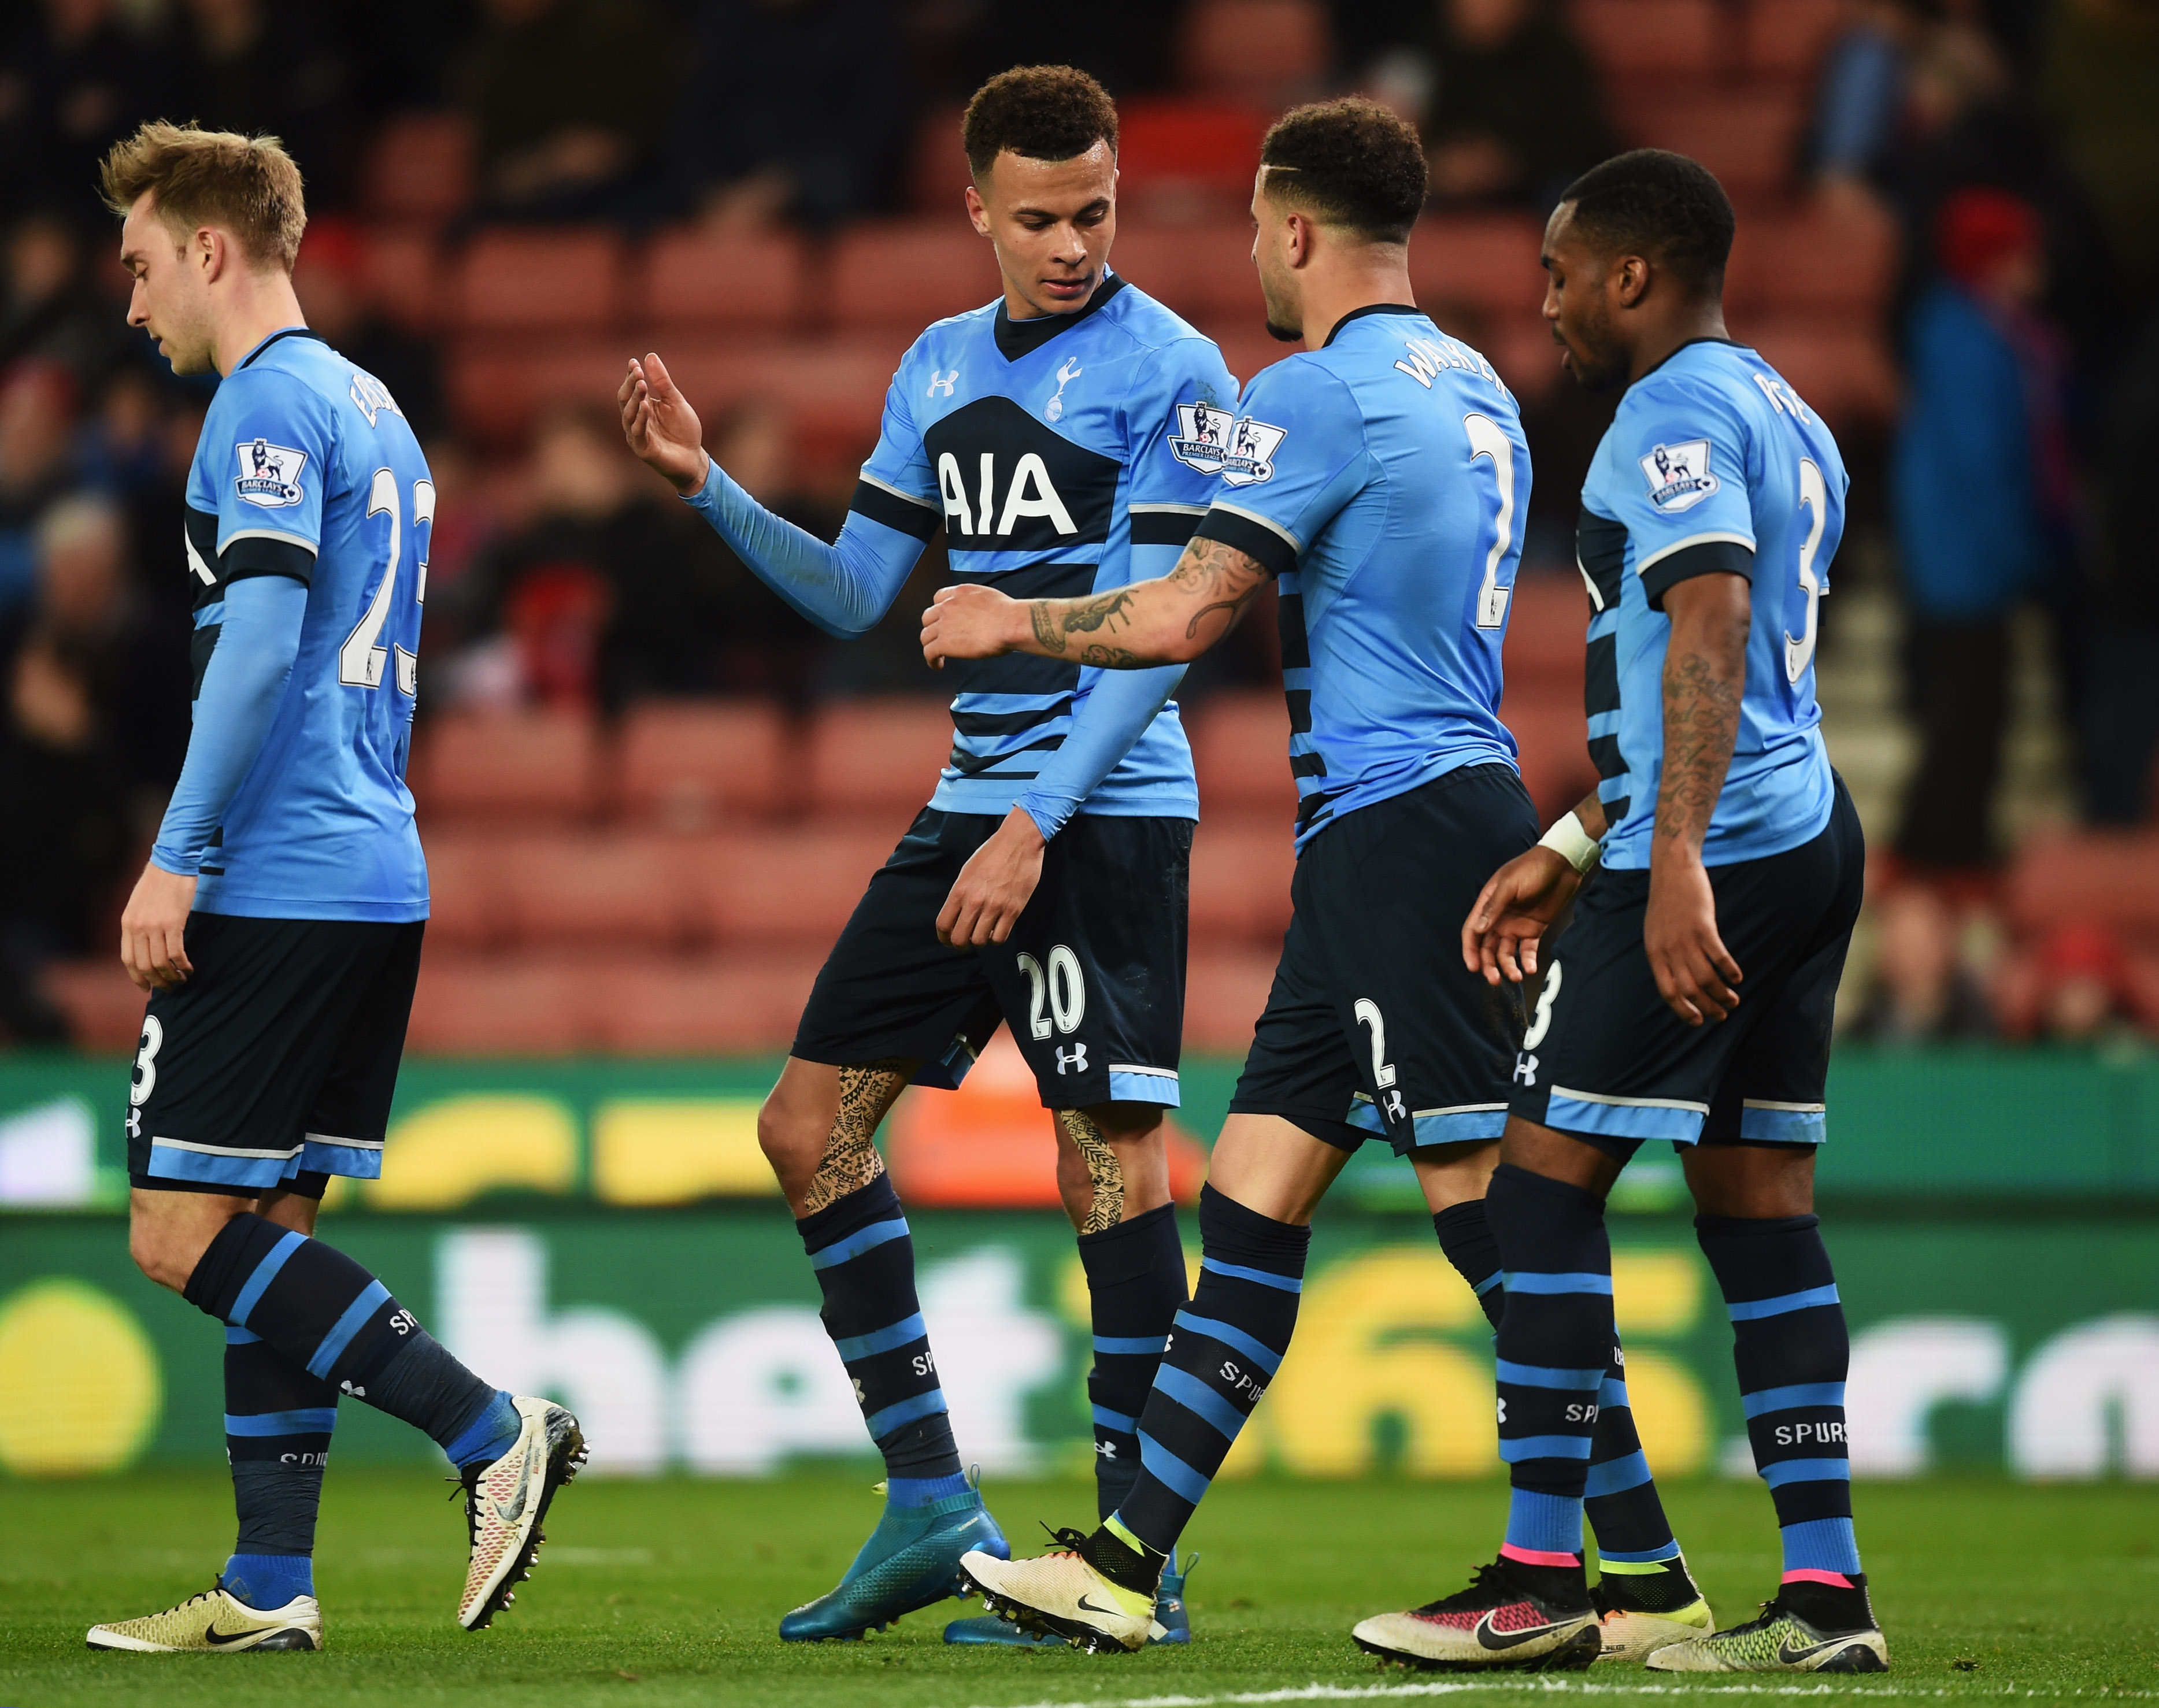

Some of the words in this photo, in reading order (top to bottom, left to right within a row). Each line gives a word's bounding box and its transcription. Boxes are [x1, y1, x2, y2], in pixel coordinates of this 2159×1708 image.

[242, 480, 282, 492] BARCLAYS
[938, 452, 1079, 535] AIA
[1183, 443, 1220, 456] BARCLAYS
[1226, 458, 1253, 469] ARCLAYS
[1464, 412, 1514, 630] 2
[1784, 457, 1825, 686] 3
[1016, 944, 1086, 1040] 20
[1523, 959, 1562, 1050] 3
[129, 1014, 164, 1106] 3
[1353, 997, 1397, 1090] 2
